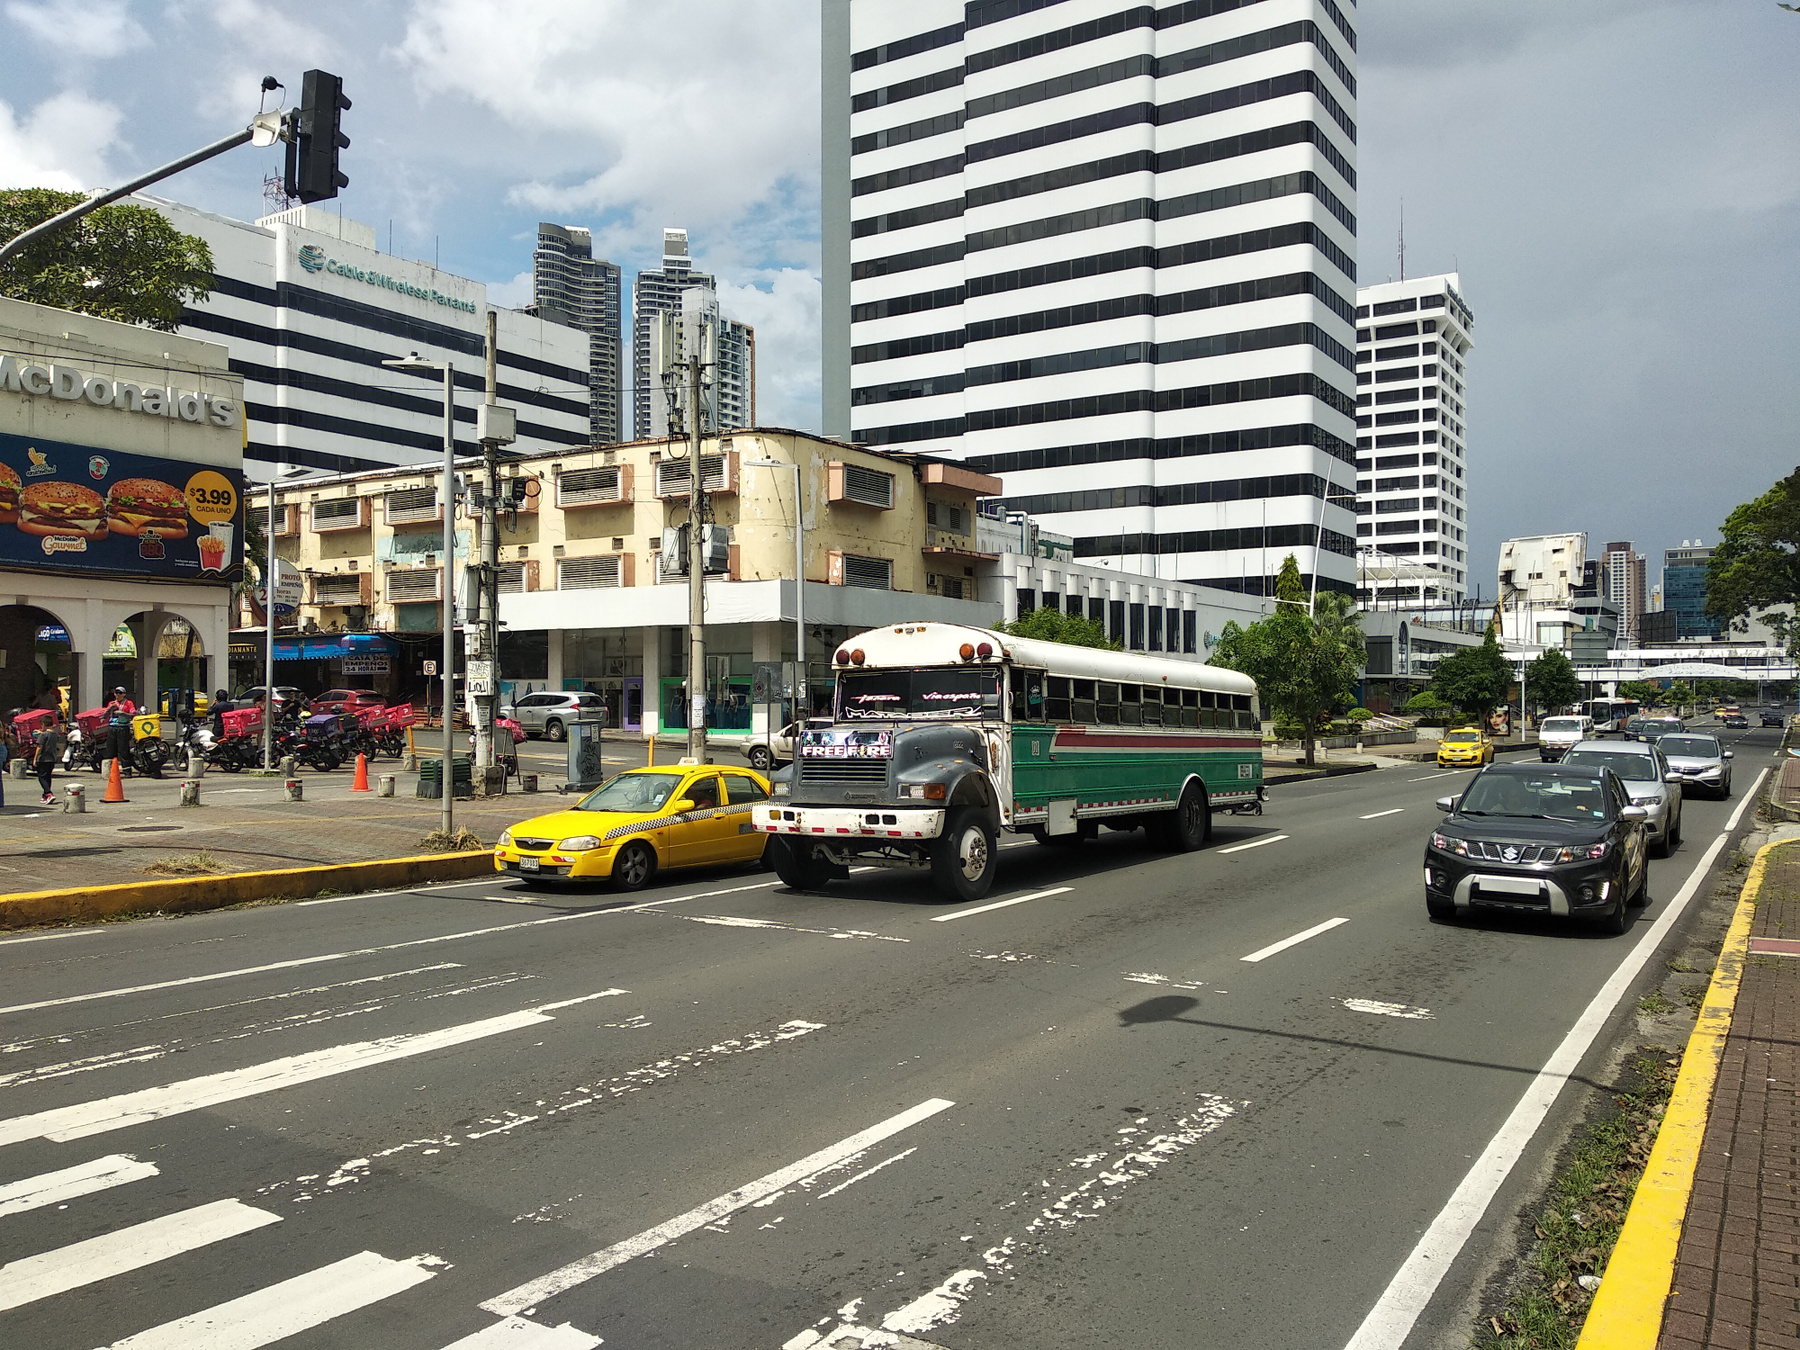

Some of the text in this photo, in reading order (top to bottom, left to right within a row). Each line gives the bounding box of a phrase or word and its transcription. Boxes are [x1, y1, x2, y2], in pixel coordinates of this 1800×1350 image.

[326, 259, 365, 282] Cable
[376, 274, 429, 301] Wireless
[429, 289, 477, 314] Panamá
[189, 487, 232, 506] $3.99
[196, 505, 216, 514] CADA
[43, 537, 86, 554] Gourmet
[427, 663, 433, 672] E
[802, 745, 844, 757] FREE
